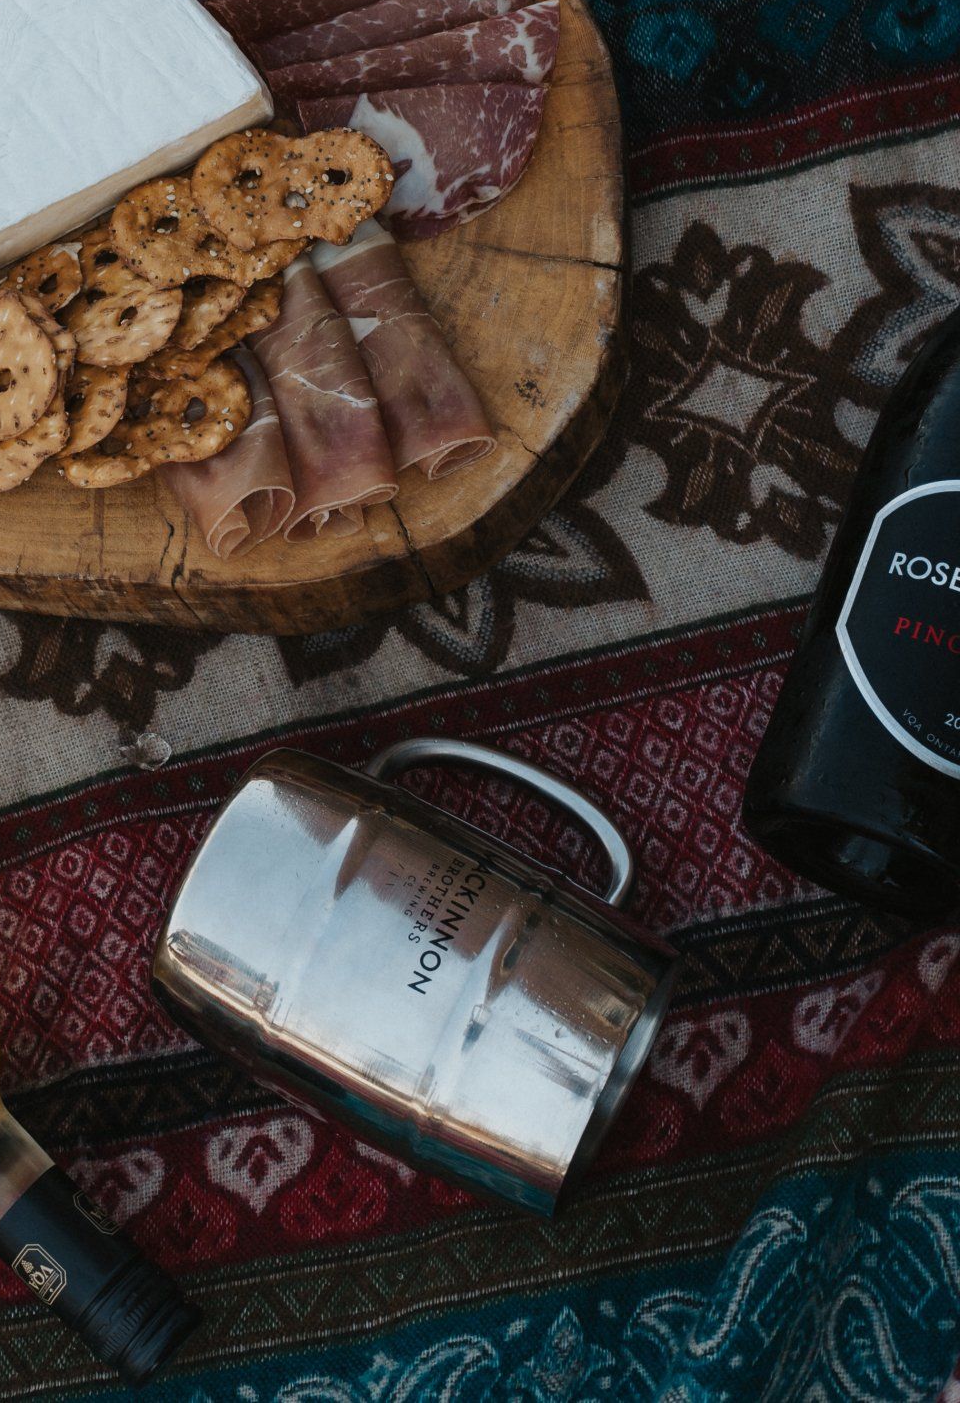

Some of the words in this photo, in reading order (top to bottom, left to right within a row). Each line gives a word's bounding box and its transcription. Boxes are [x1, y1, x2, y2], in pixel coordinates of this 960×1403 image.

[902, 708, 922, 732] VQA
[403, 863, 440, 917] BREWING
[407, 857, 466, 944] BROTHERS
[28, 1264, 54, 1290] VQA
